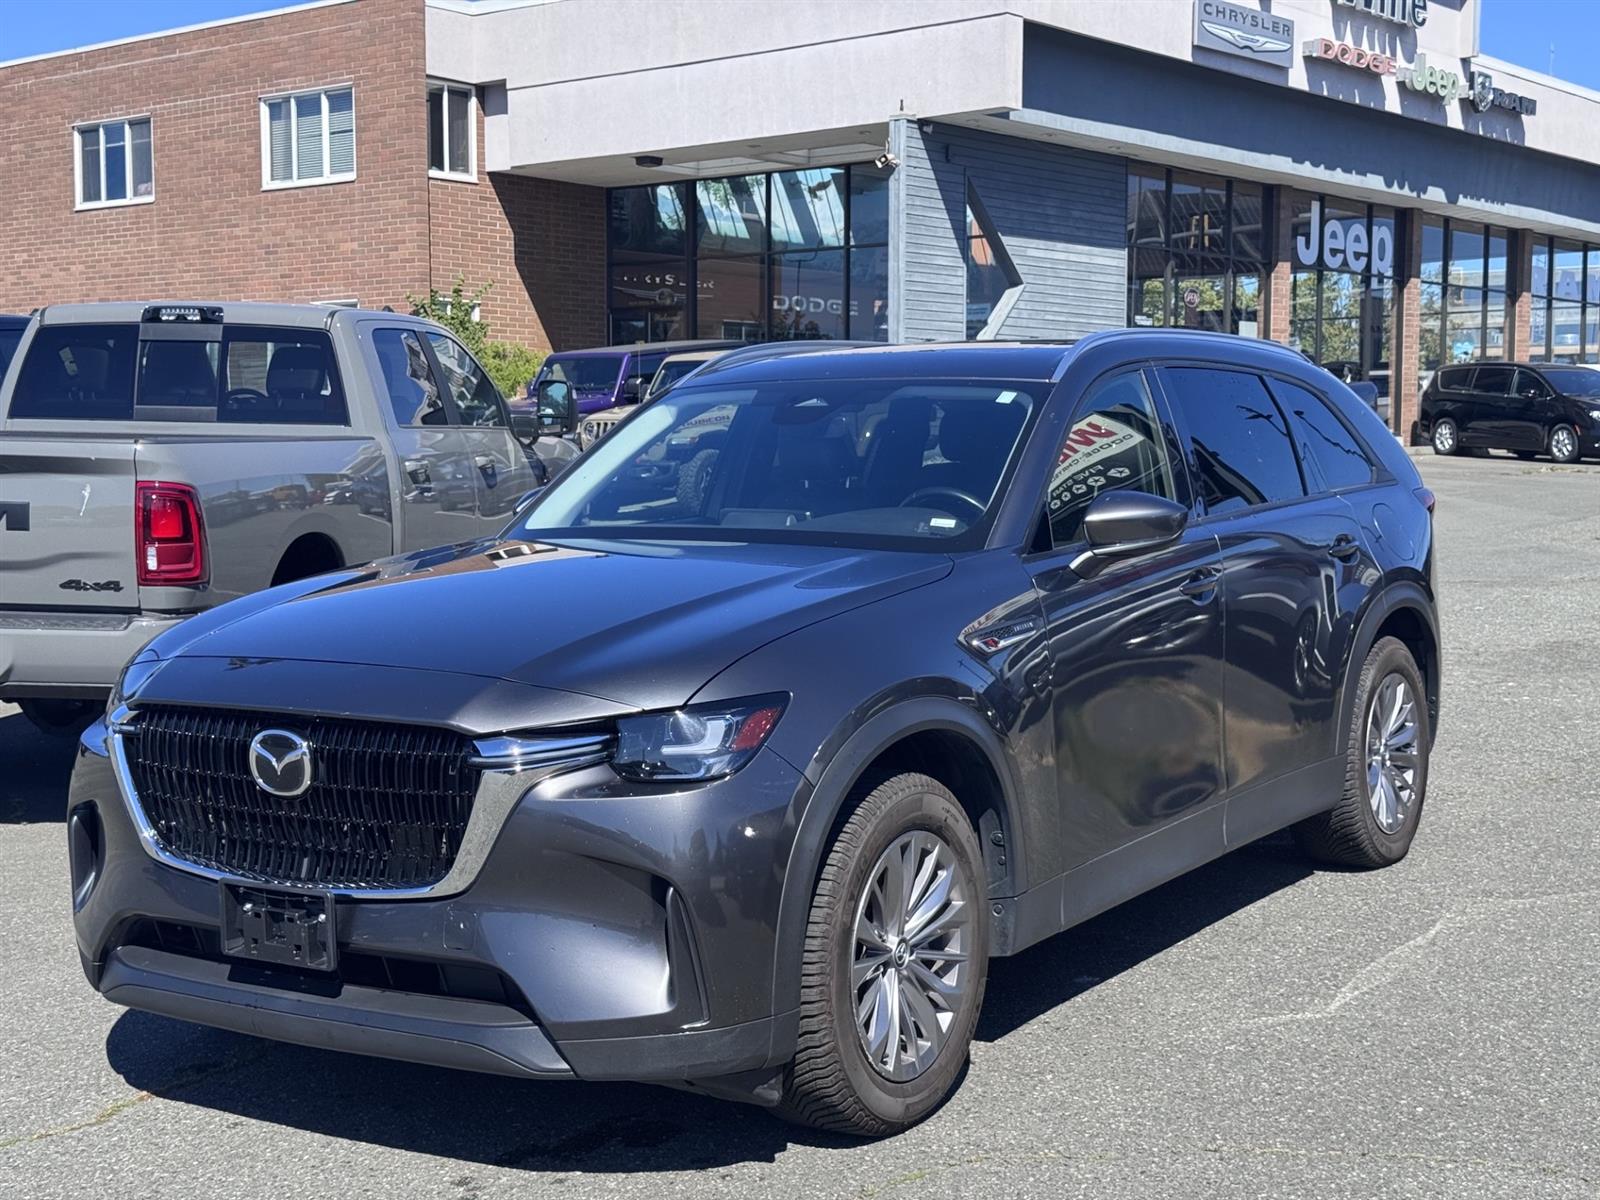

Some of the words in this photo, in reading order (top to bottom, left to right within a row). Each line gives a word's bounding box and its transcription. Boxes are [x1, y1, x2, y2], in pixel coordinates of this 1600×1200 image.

[1202, 3, 1292, 38] CHRYSLER
[1318, 38, 1397, 75] DODGE
[1409, 53, 1460, 105] Jeep
[1494, 87, 1537, 116] RAM
[1297, 200, 1393, 289] Jeep
[773, 295, 859, 316] DODGE
[59, 579, 124, 593] 4x4
